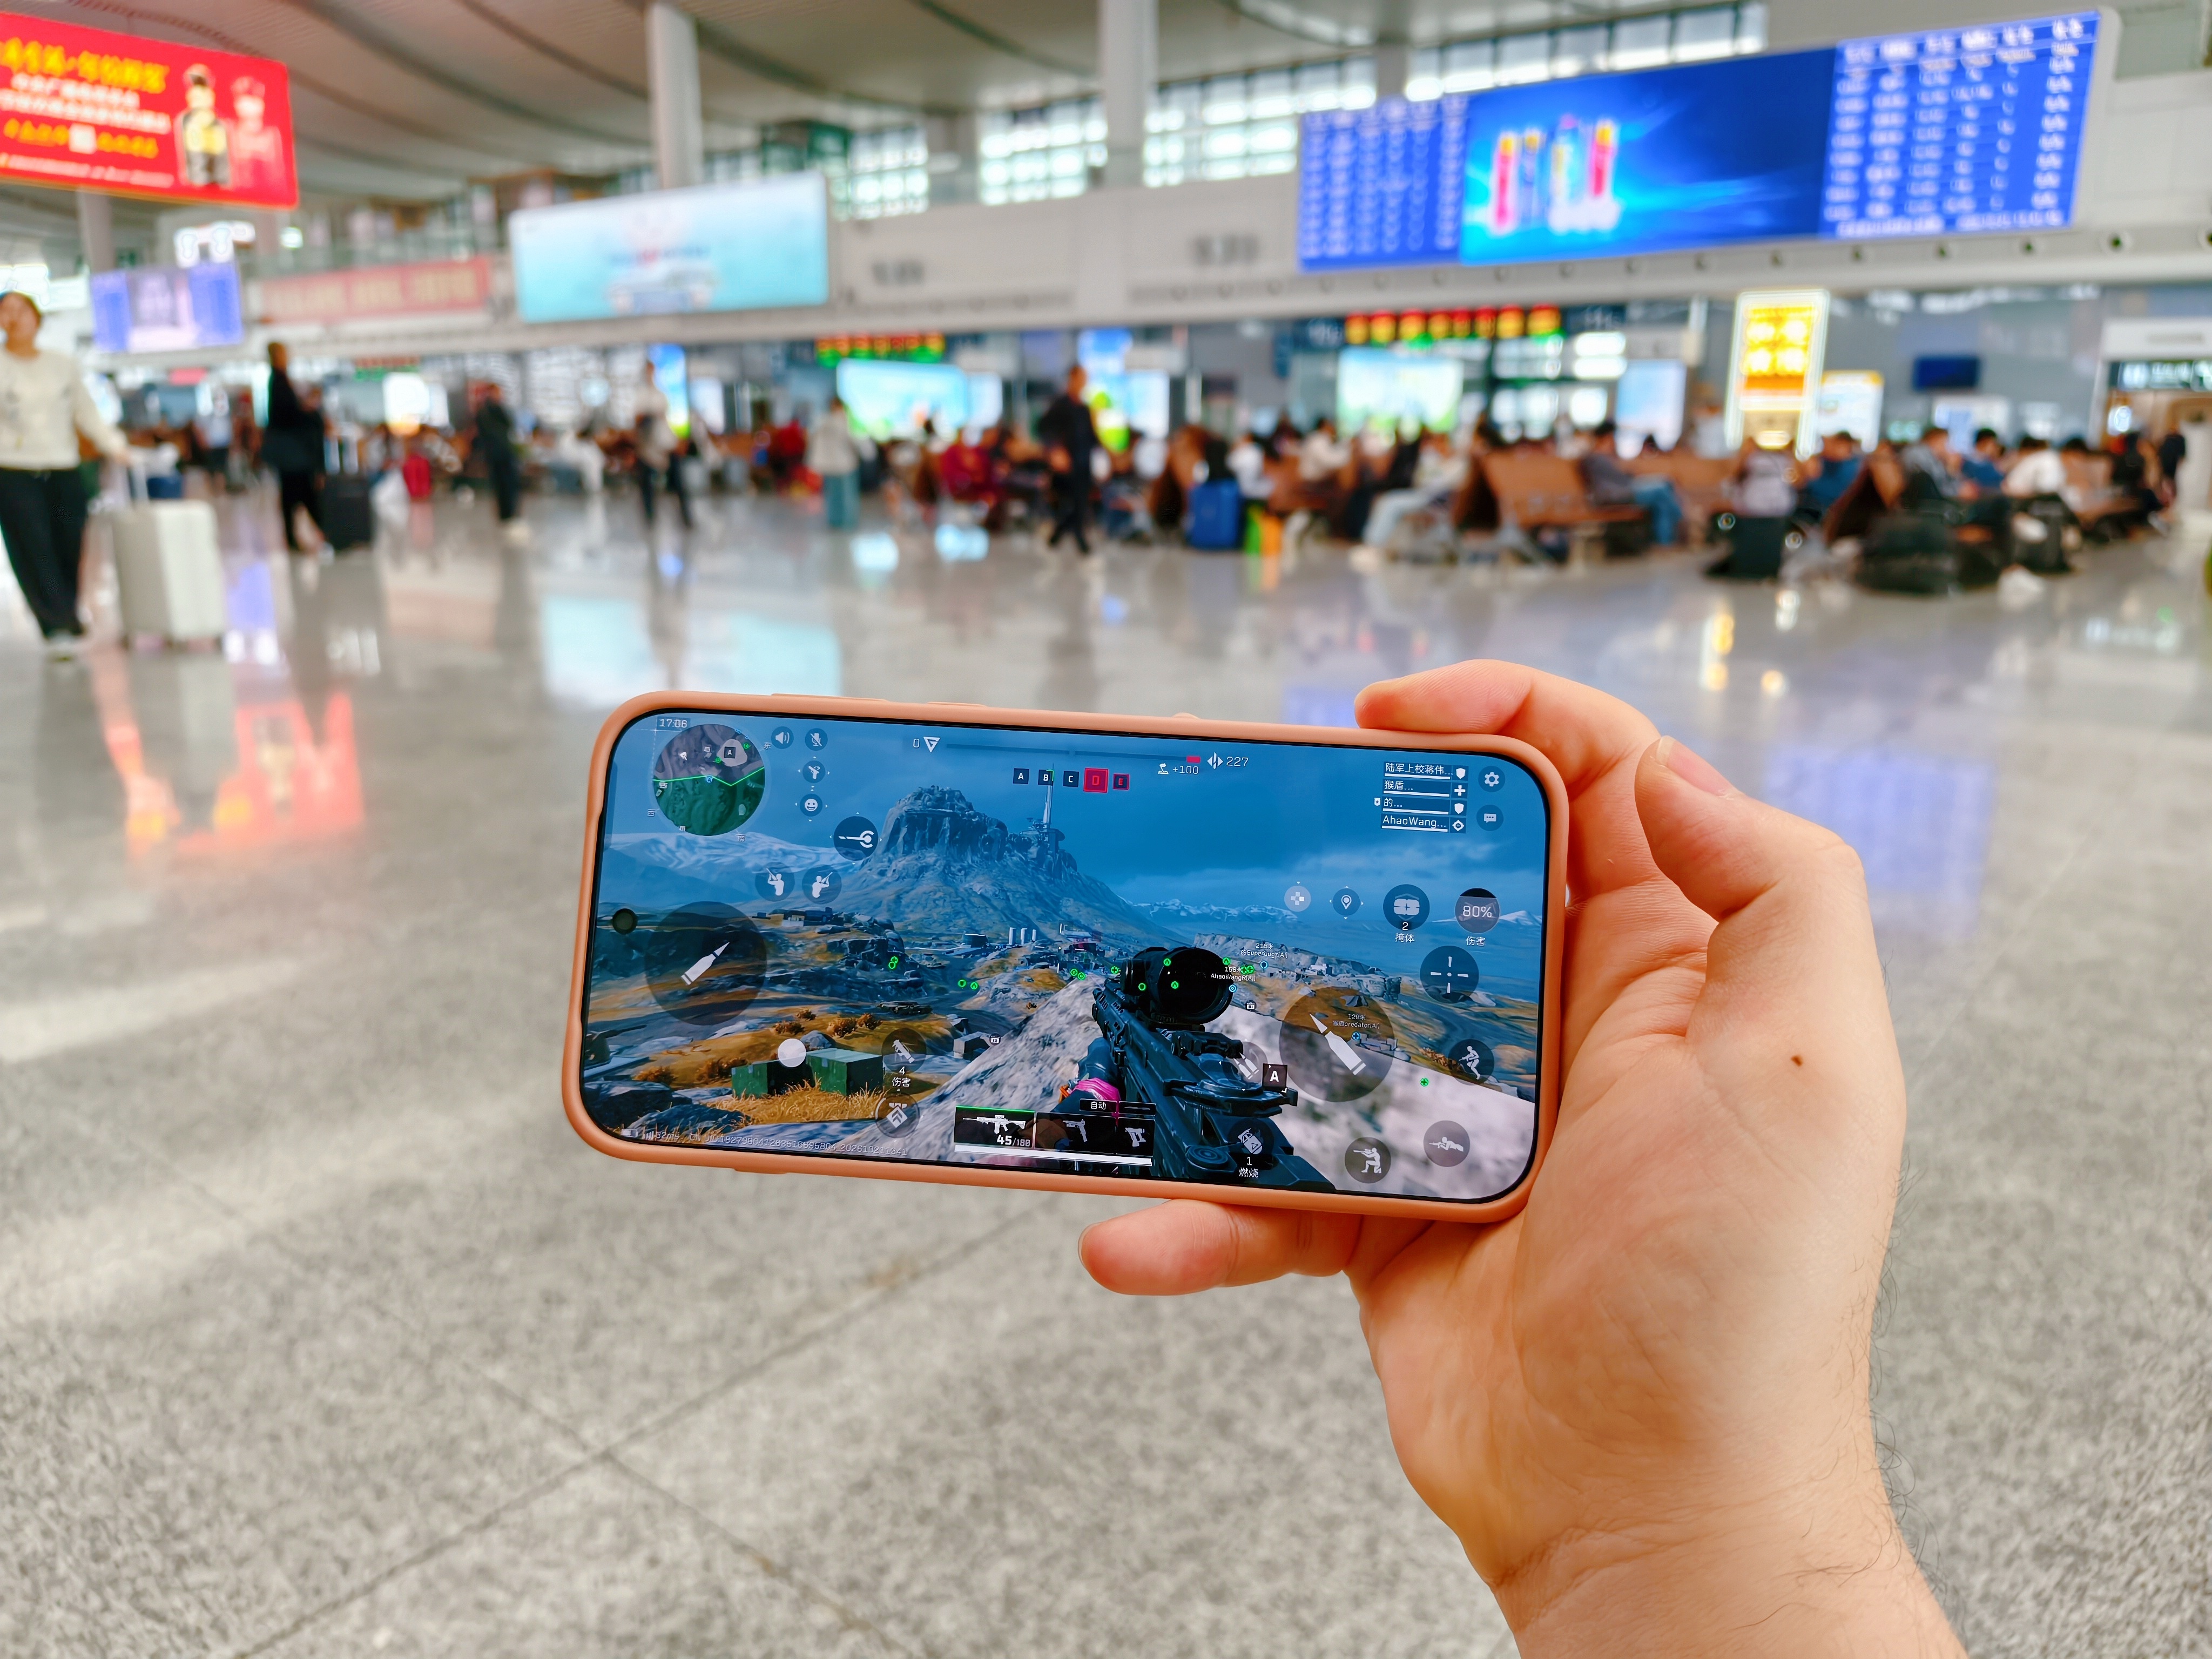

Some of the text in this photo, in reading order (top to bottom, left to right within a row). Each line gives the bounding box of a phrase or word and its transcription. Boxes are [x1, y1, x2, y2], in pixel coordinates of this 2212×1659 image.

[659, 719, 687, 728] 17:06
[913, 738, 920, 748] 0
[1226, 756, 1249, 767] 227
[1172, 765, 1199, 774] +100
[1017, 772, 1024, 780] A
[1092, 775, 1100, 785] D
[1118, 778, 1124, 786] E
[1462, 905, 1492, 918] 80%
[1402, 922, 1408, 930] 2
[1395, 933, 1415, 943] 掩体
[1466, 936, 1486, 946] 伤害
[899, 1066, 906, 1075] 4
[1270, 1070, 1279, 1082] A
[892, 1076, 911, 1087] 伤害
[1091, 1101, 1107, 1110] 自动
[996, 1134, 1030, 1147] 45/180
[1246, 1156, 1252, 1165] 1
[1239, 1167, 1259, 1178] 燃烧
